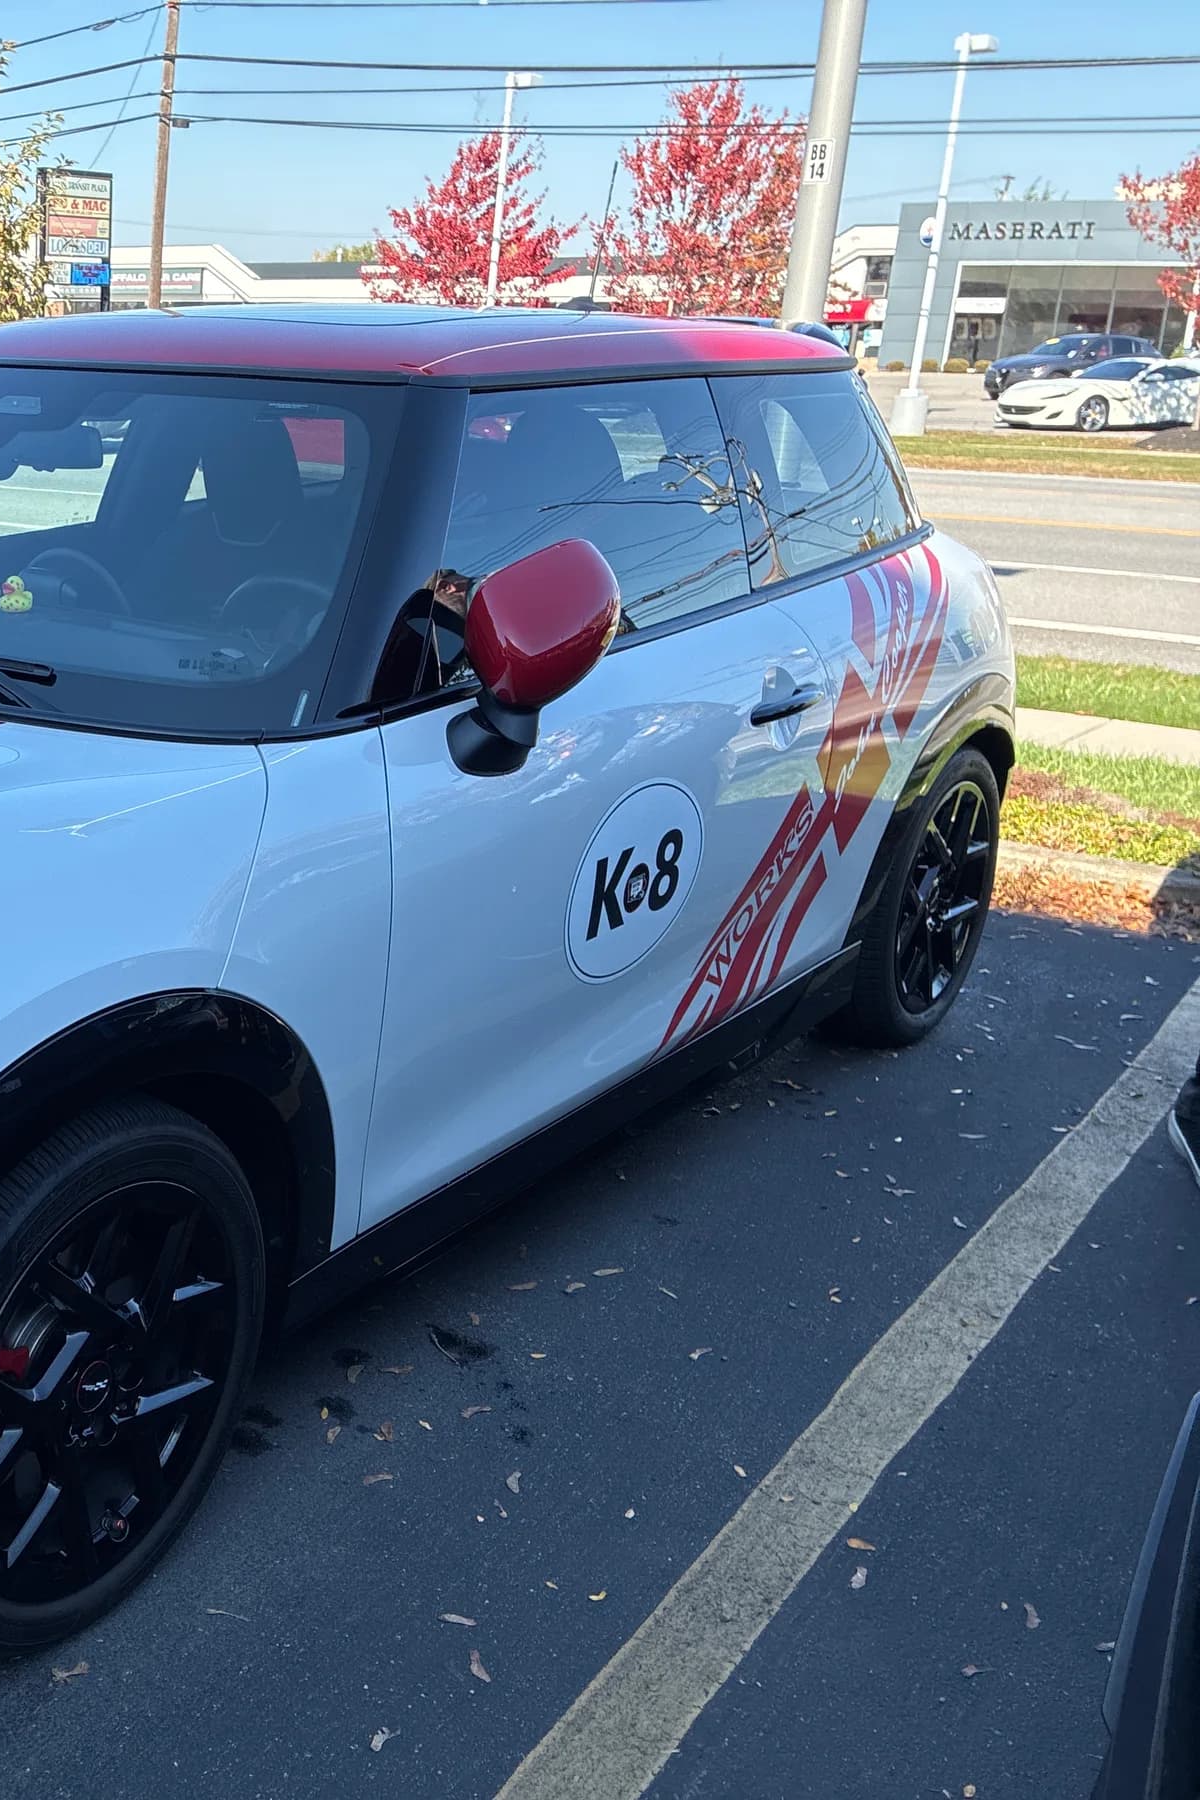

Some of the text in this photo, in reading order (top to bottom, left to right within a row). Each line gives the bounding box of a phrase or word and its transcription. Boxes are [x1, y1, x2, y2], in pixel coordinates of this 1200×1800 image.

[811, 144, 827, 161] BB
[810, 162, 824, 179] 14
[71, 199, 79, 209] &
[82, 200, 107, 212] MAC
[949, 222, 1096, 240] MASERATI
[706, 800, 814, 987] WORKS
